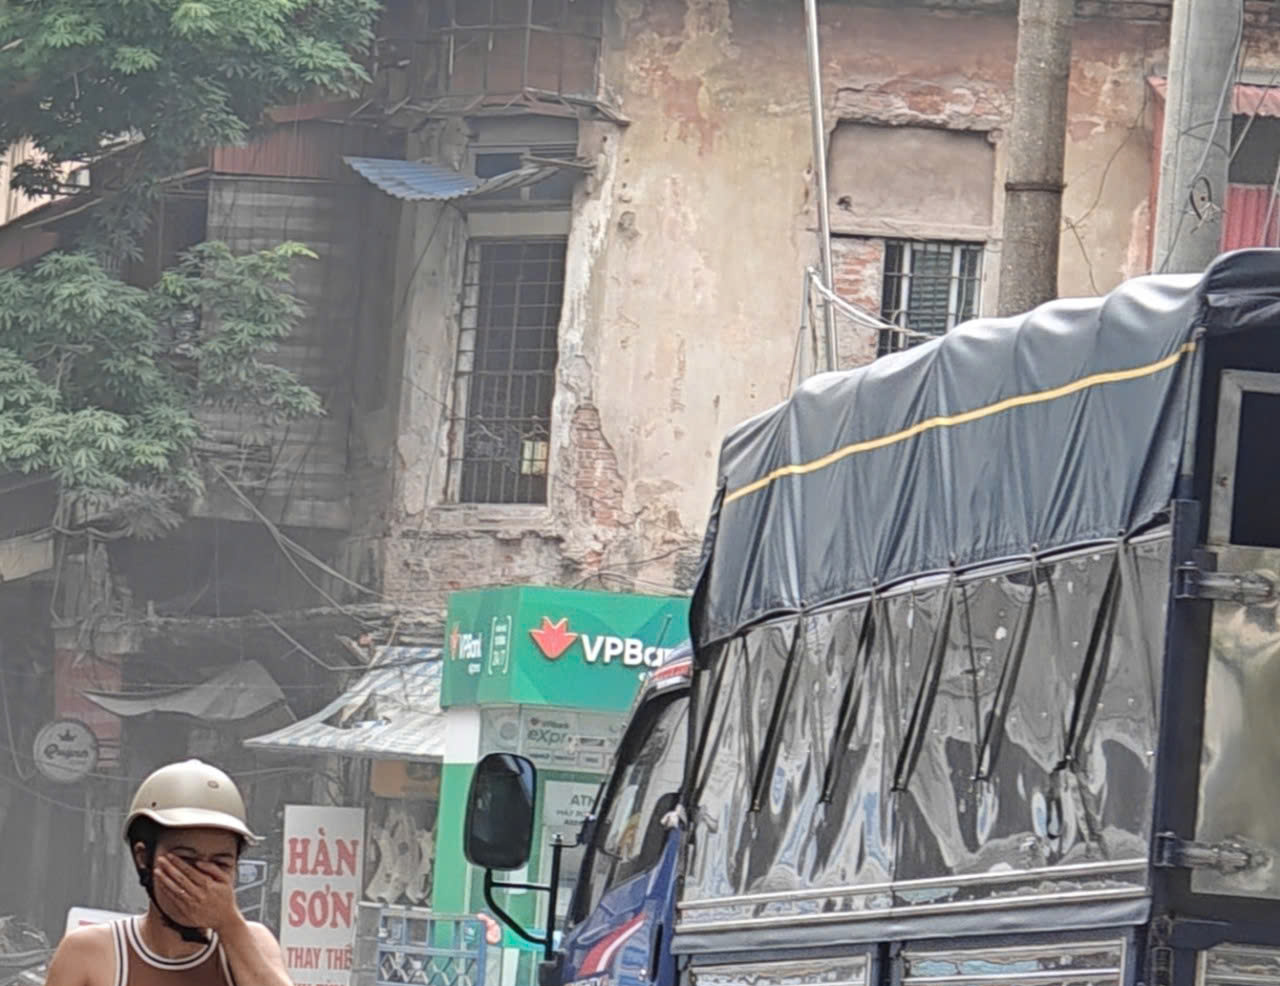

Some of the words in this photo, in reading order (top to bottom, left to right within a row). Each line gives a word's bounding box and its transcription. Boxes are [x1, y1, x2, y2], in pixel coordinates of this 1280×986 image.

[581, 634, 673, 667] VPBa
[287, 827, 359, 876] HÀN
[288, 884, 354, 928] SƠN
[287, 947, 321, 969] THAY
